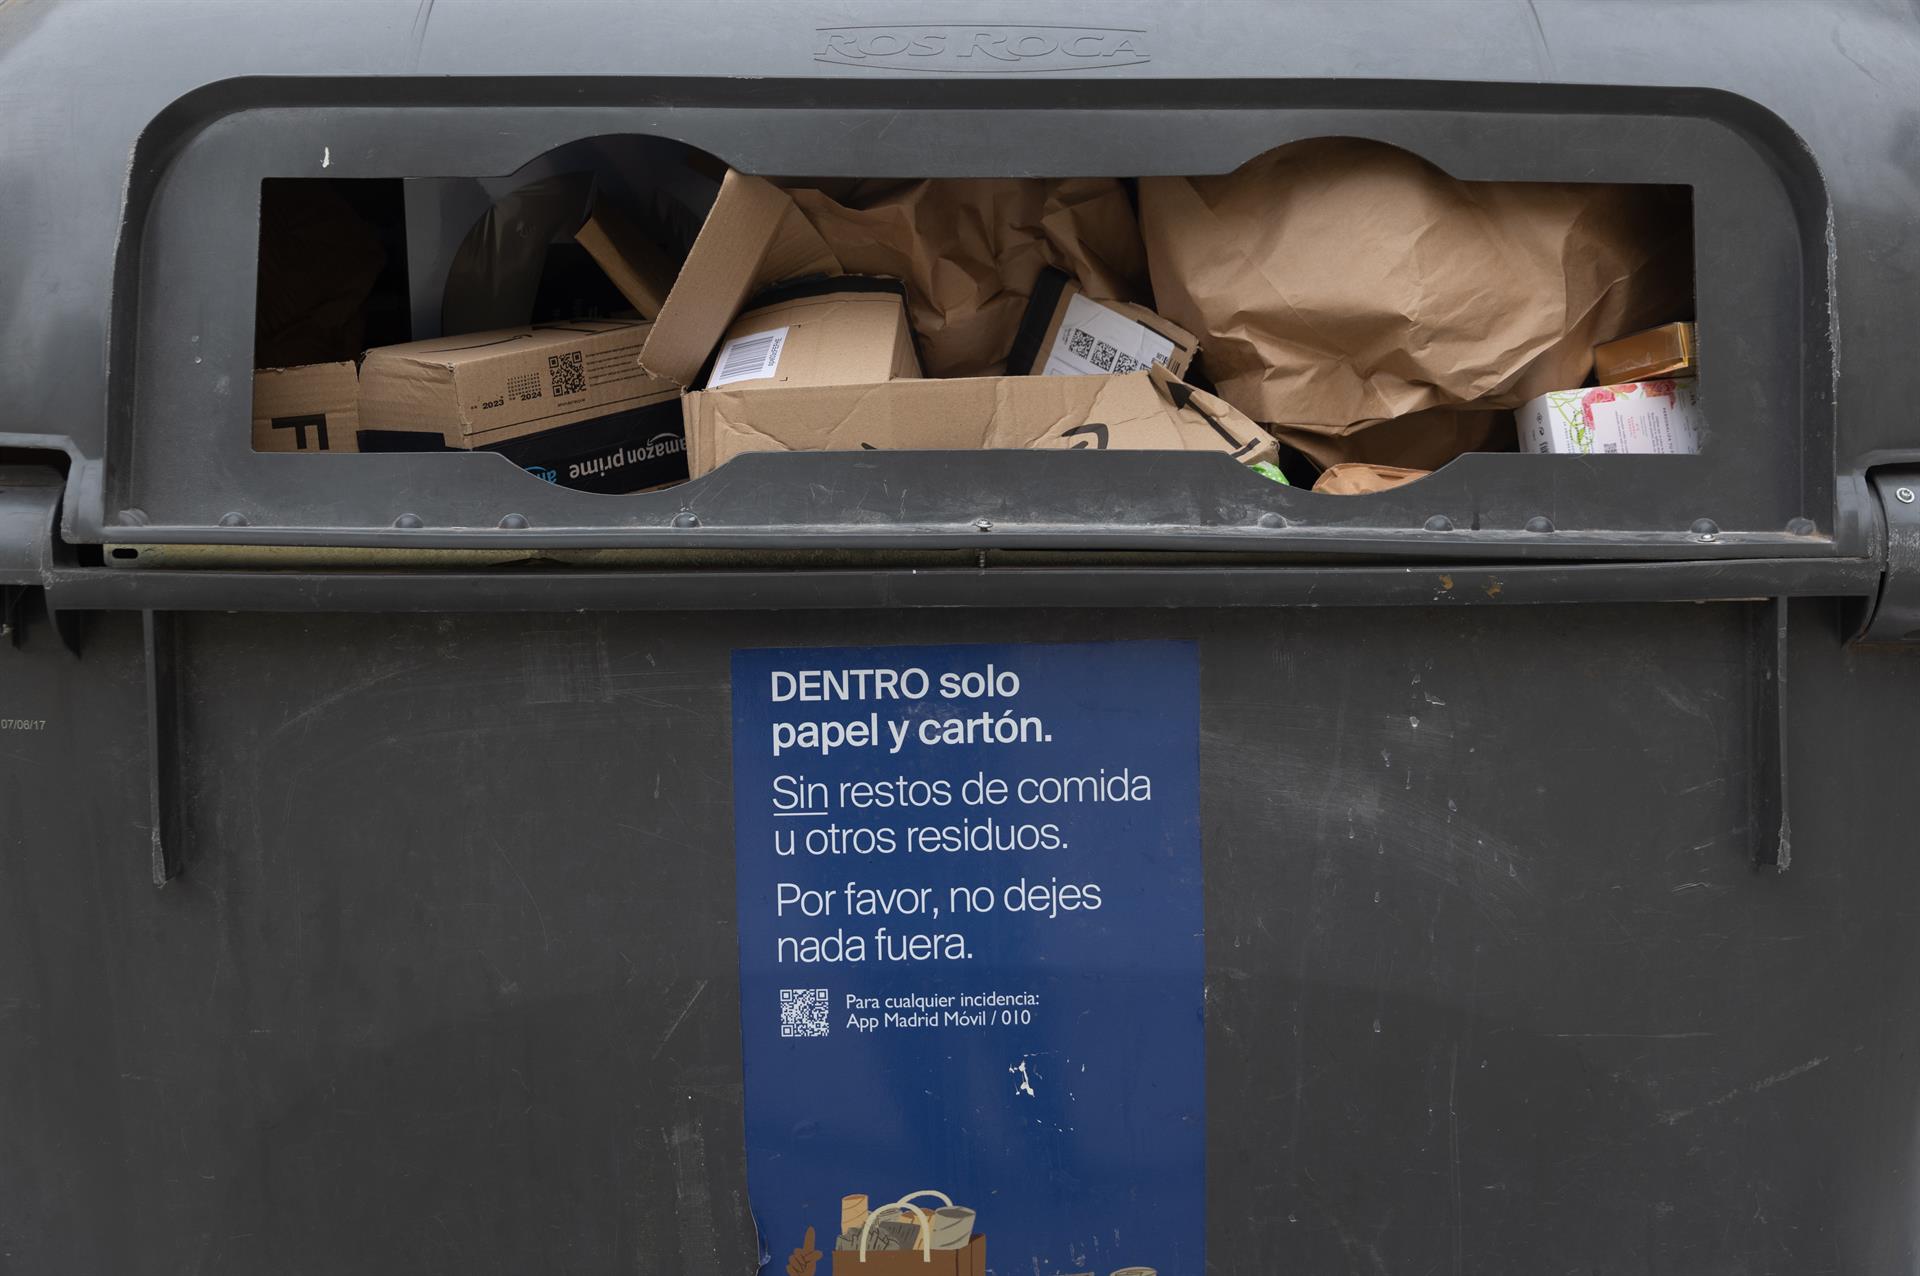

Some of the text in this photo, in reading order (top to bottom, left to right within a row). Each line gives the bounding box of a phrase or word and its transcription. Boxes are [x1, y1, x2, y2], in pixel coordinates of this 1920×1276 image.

[813, 33, 1151, 61] ROS ROCA
[482, 399, 504, 409] 2023
[520, 390, 542, 401] 2024
[569, 448, 625, 479] prime
[627, 437, 688, 465] amazon
[771, 663, 1020, 702] DENTRO solo
[772, 709, 1052, 757] papel y cartón.
[772, 767, 1151, 811] Sin restos de comida
[775, 817, 1068, 856] u otros residuos.
[777, 876, 1102, 920] Por favor, no dejes
[777, 927, 973, 963] nada fuera.
[846, 991, 1040, 1012] Para cualquier incidencia:
[846, 1009, 1031, 1033] App Madrid Móvil / 010
